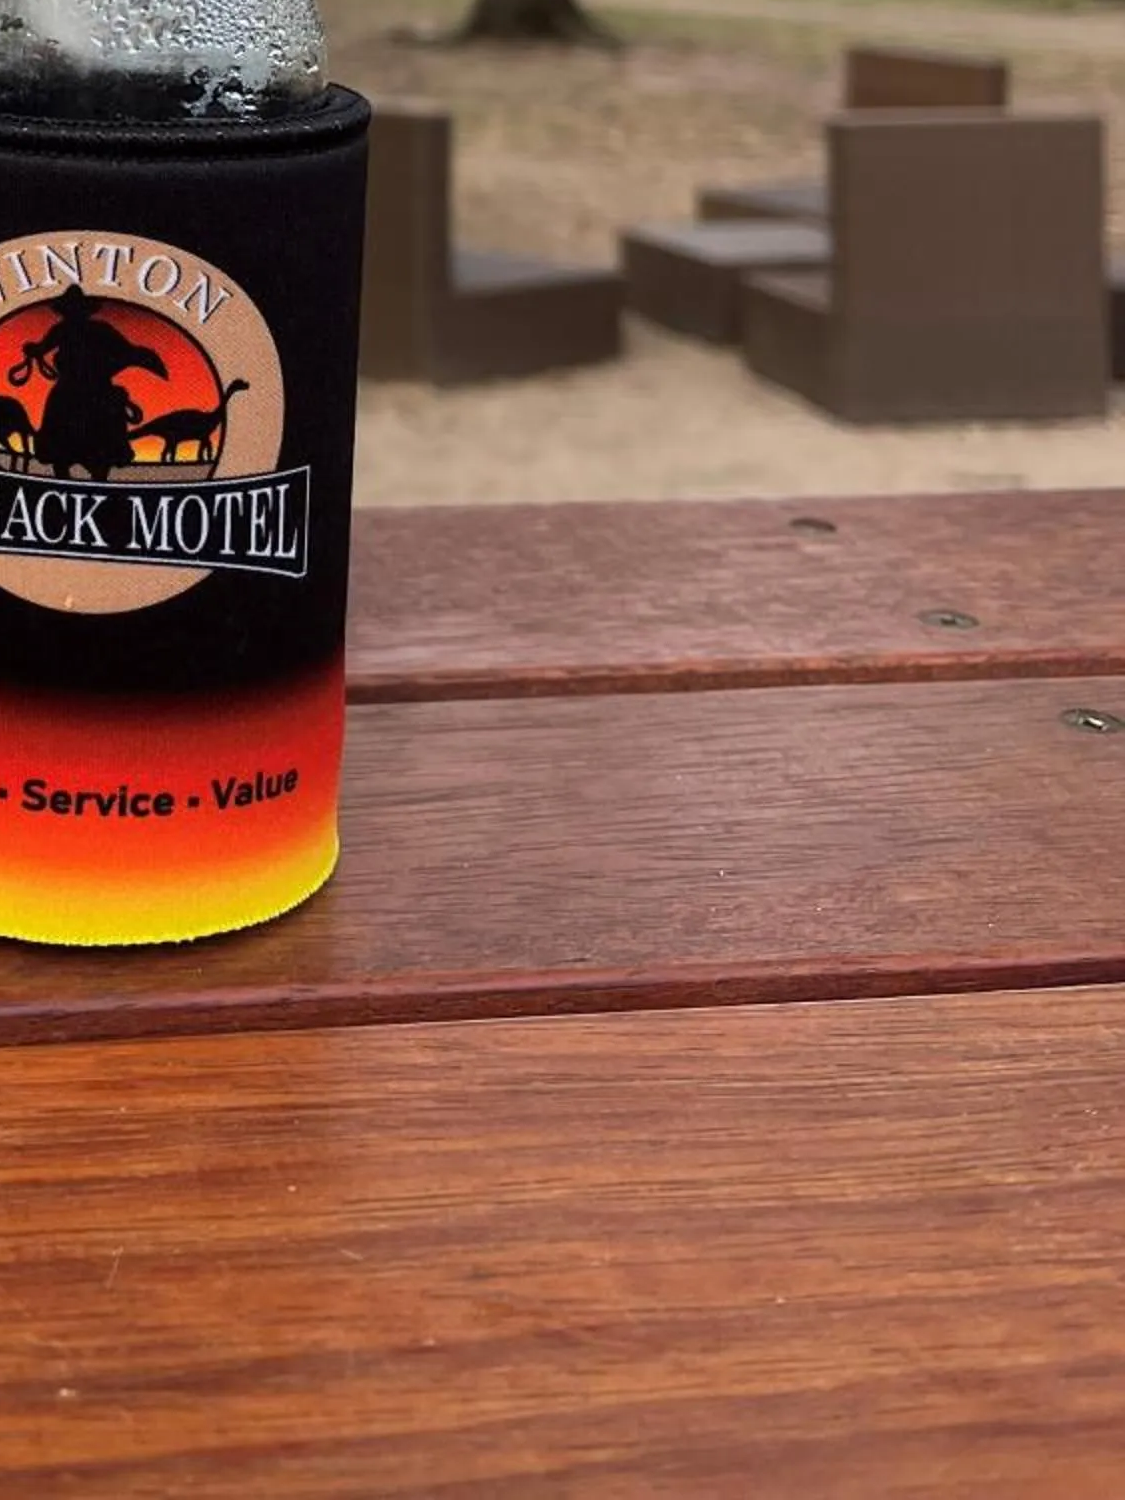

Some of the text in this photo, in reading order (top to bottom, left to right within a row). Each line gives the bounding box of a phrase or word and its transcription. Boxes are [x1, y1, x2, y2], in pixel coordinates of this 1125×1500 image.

[126, 484, 298, 559] MOTEL
[22, 780, 173, 817] Service
[210, 766, 299, 809] Value
